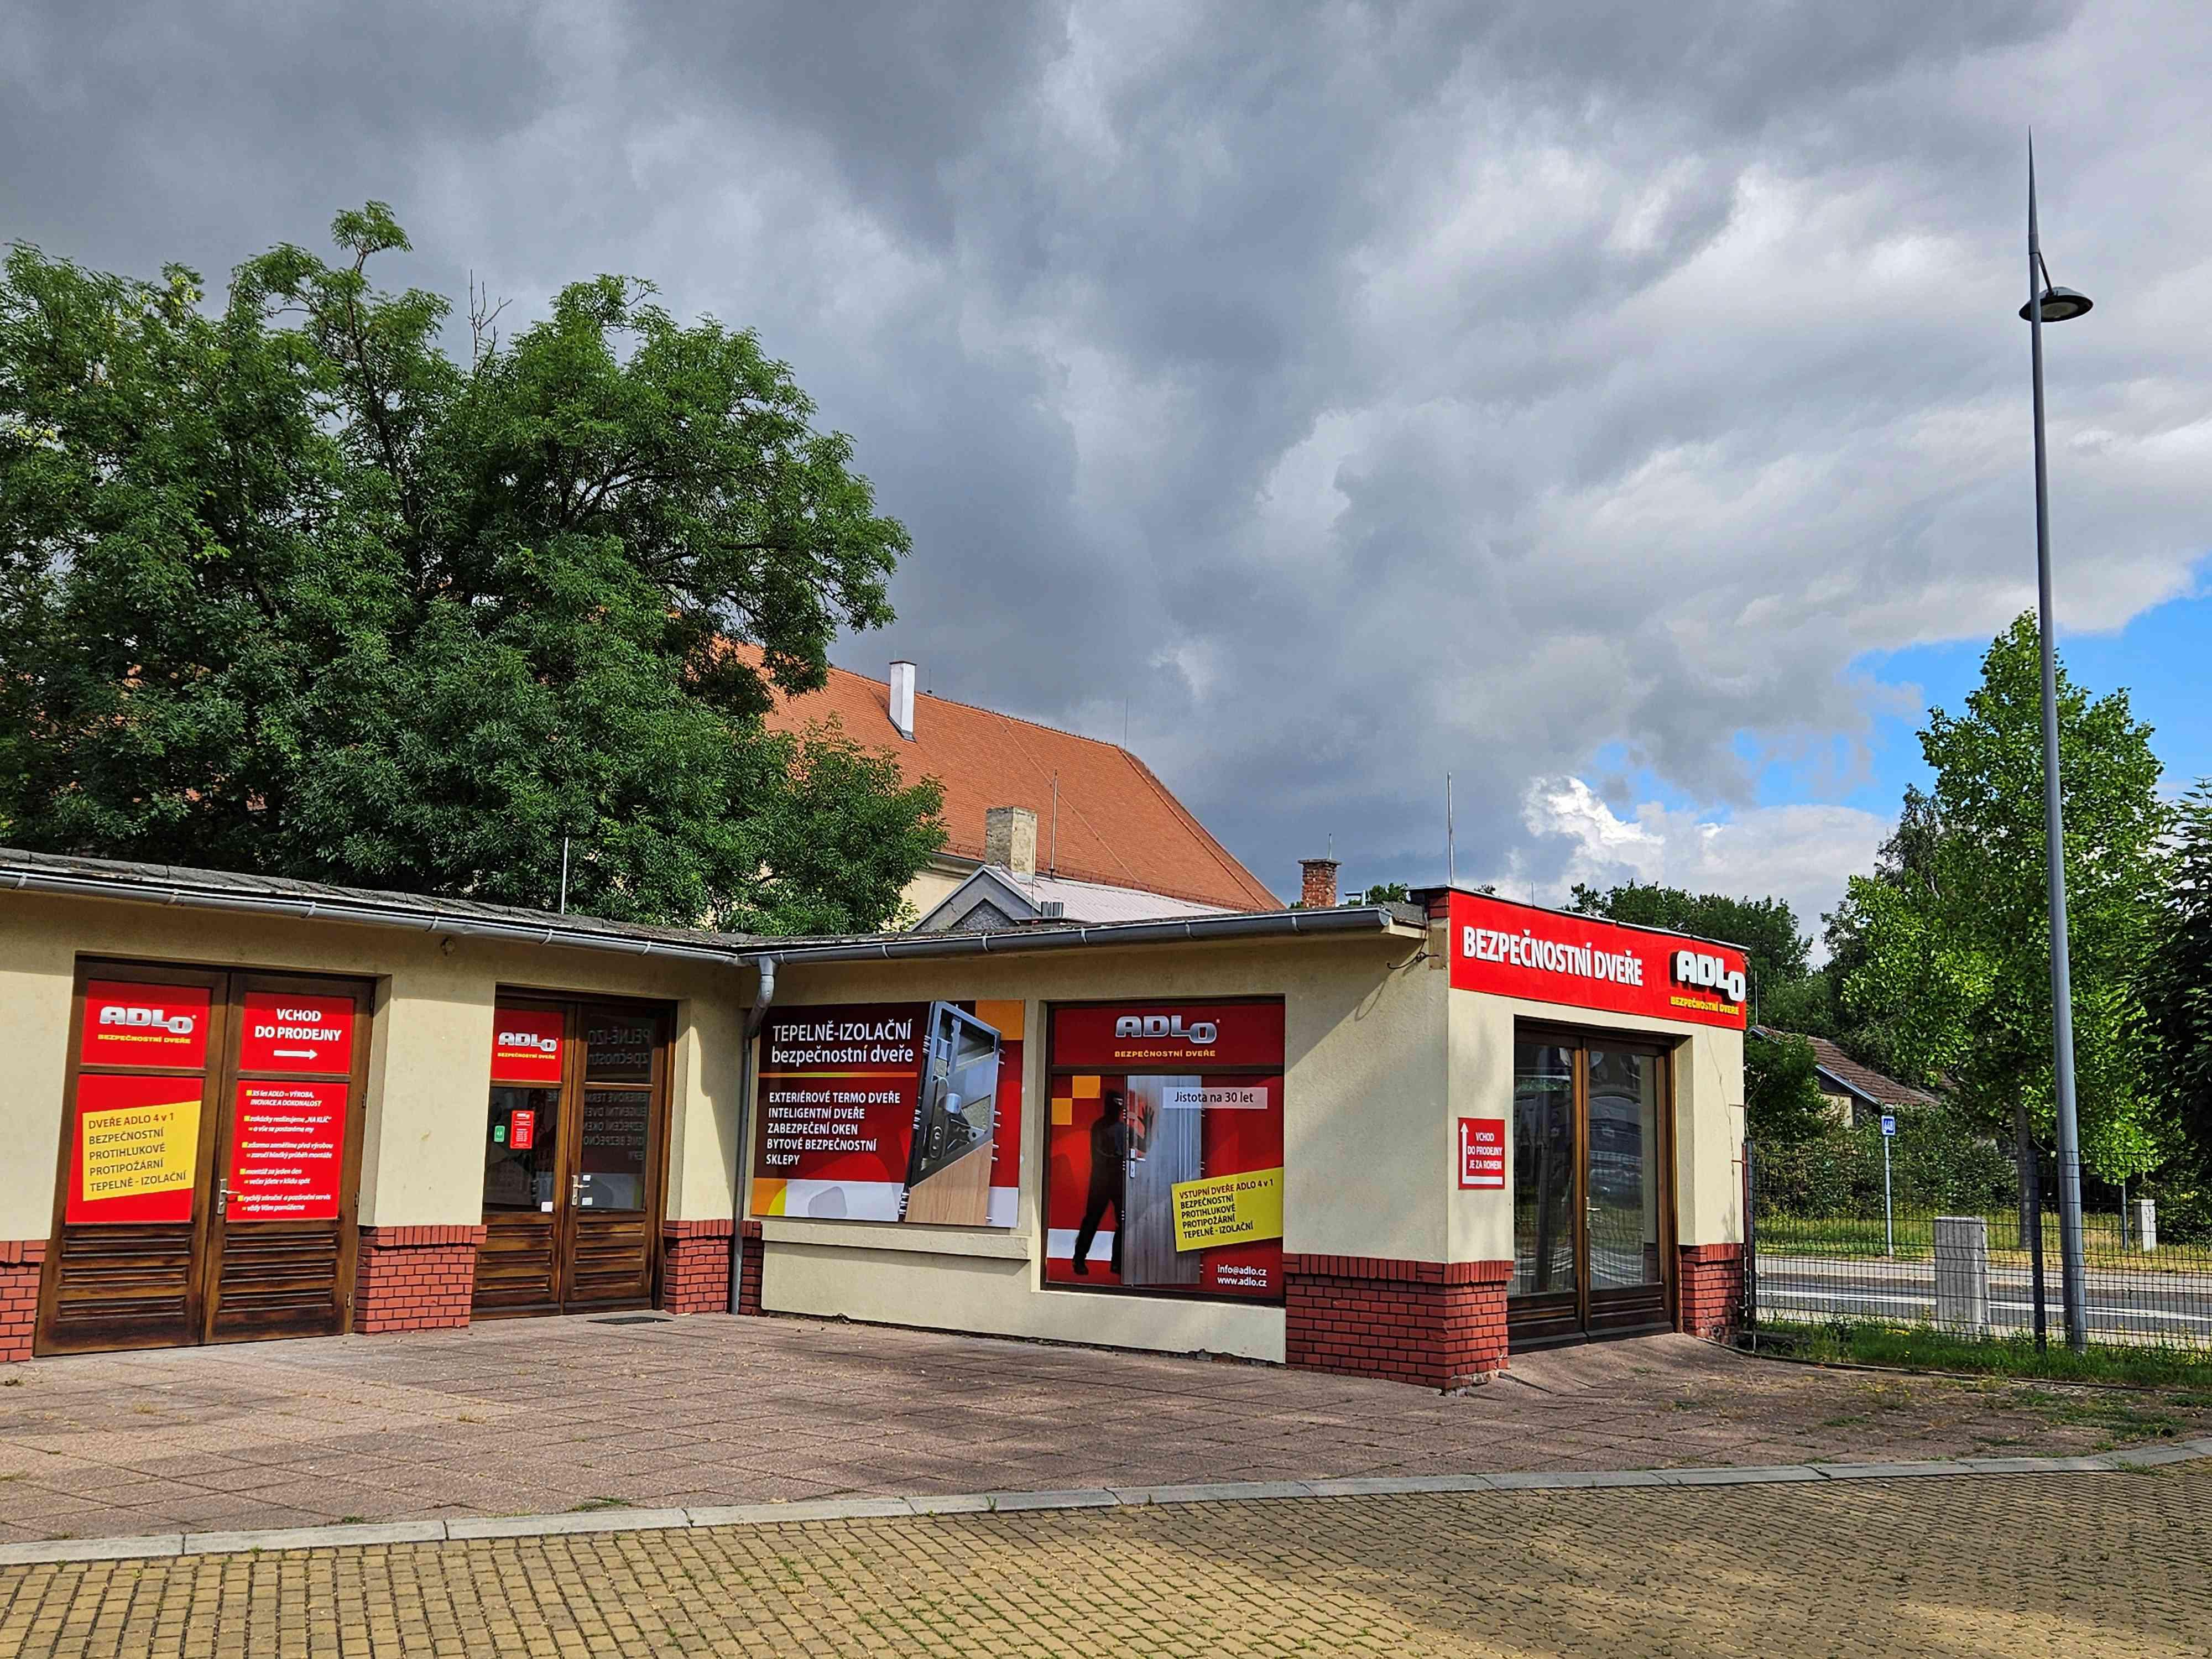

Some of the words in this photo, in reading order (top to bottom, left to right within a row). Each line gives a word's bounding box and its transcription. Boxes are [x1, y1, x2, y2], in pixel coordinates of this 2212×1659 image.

[1463, 926, 1592, 978] BEZPEČNOSTNÍ
[1593, 950, 1644, 987] DVEŘE
[1677, 950, 1746, 1002] ADLO
[1670, 996, 1719, 1012] BEZPEČNOSTNÍ
[100, 1006, 194, 1034] ADLO
[276, 1008, 321, 1022] VCHOD
[255, 1026, 275, 1038] DO
[277, 1027, 342, 1041] PRODEJNY
[773, 1019, 912, 1042] TEPELNĚ-IZOLAČNÍ
[1115, 1015, 1217, 1044] ADLO
[98, 1034, 161, 1042] BEZPEČNOSTNÍ
[498, 1032, 557, 1052] ADLO
[771, 1045, 868, 1067] bezpečnostní
[870, 1044, 914, 1062] dveře
[1114, 1049, 1183, 1057] BEZPEČNOSTNÍ
[1186, 1049, 1215, 1057] DVEŘE
[769, 1090, 830, 1103] EXTERIÉROVÉ
[832, 1092, 866, 1103] TERMO
[868, 1091, 900, 1103] DVEŘE
[1175, 1092, 1207, 1103] Jistota
[1210, 1094, 1222, 1103] na
[1225, 1092, 1237, 1103] 30
[1240, 1092, 1253, 1103] let
[768, 1106, 832, 1119] INTELIGENTNÍ
[834, 1107, 865, 1119] DVEŘE
[89, 1117, 122, 1129] DVEŘE
[124, 1115, 150, 1125] ADLO
[153, 1114, 159, 1122] 4
[767, 1121, 830, 1134] ZABEZPEČENÍ
[832, 1124, 858, 1135] OKEN
[89, 1126, 164, 1145] BEZPEČNOSTNÍ
[1475, 1132, 1494, 1142] VCHOD
[89, 1143, 165, 1160] PROTIHLUKOVÉ
[767, 1137, 803, 1150] BYTOVÉ
[805, 1138, 877, 1151] BEZPEČNOSTNÍ
[1467, 1146, 1475, 1155] DO
[1476, 1146, 1503, 1156] PRODEJNY
[90, 1157, 163, 1176] PROTIPOŽÁRNÍ
[766, 1154, 800, 1165] SKLEPY
[1469, 1159, 1475, 1169] JE
[1475, 1159, 1483, 1169] ZA
[90, 1177, 133, 1192] TEPELNĚ
[141, 1170, 186, 1186] IZOLAČNÍ
[1179, 1187, 1210, 1199] VSTUPNÍ
[1211, 1183, 1234, 1195] DVEŘE
[1236, 1181, 1256, 1191] ADLO
[1181, 1194, 1234, 1209] BEZPEČNOSTNÍ
[1181, 1204, 1235, 1219] PROTIHLUKOVÉ
[1182, 1213, 1235, 1229] PROTIPOŽÁRNÍ
[1183, 1227, 1214, 1239] TEPELNĚ
[1219, 1221, 1253, 1234] IZOLAČNÍ
[1217, 1264, 1267, 1276] info@adlo.cz
[1217, 1276, 1267, 1287] www.adlo.cz
